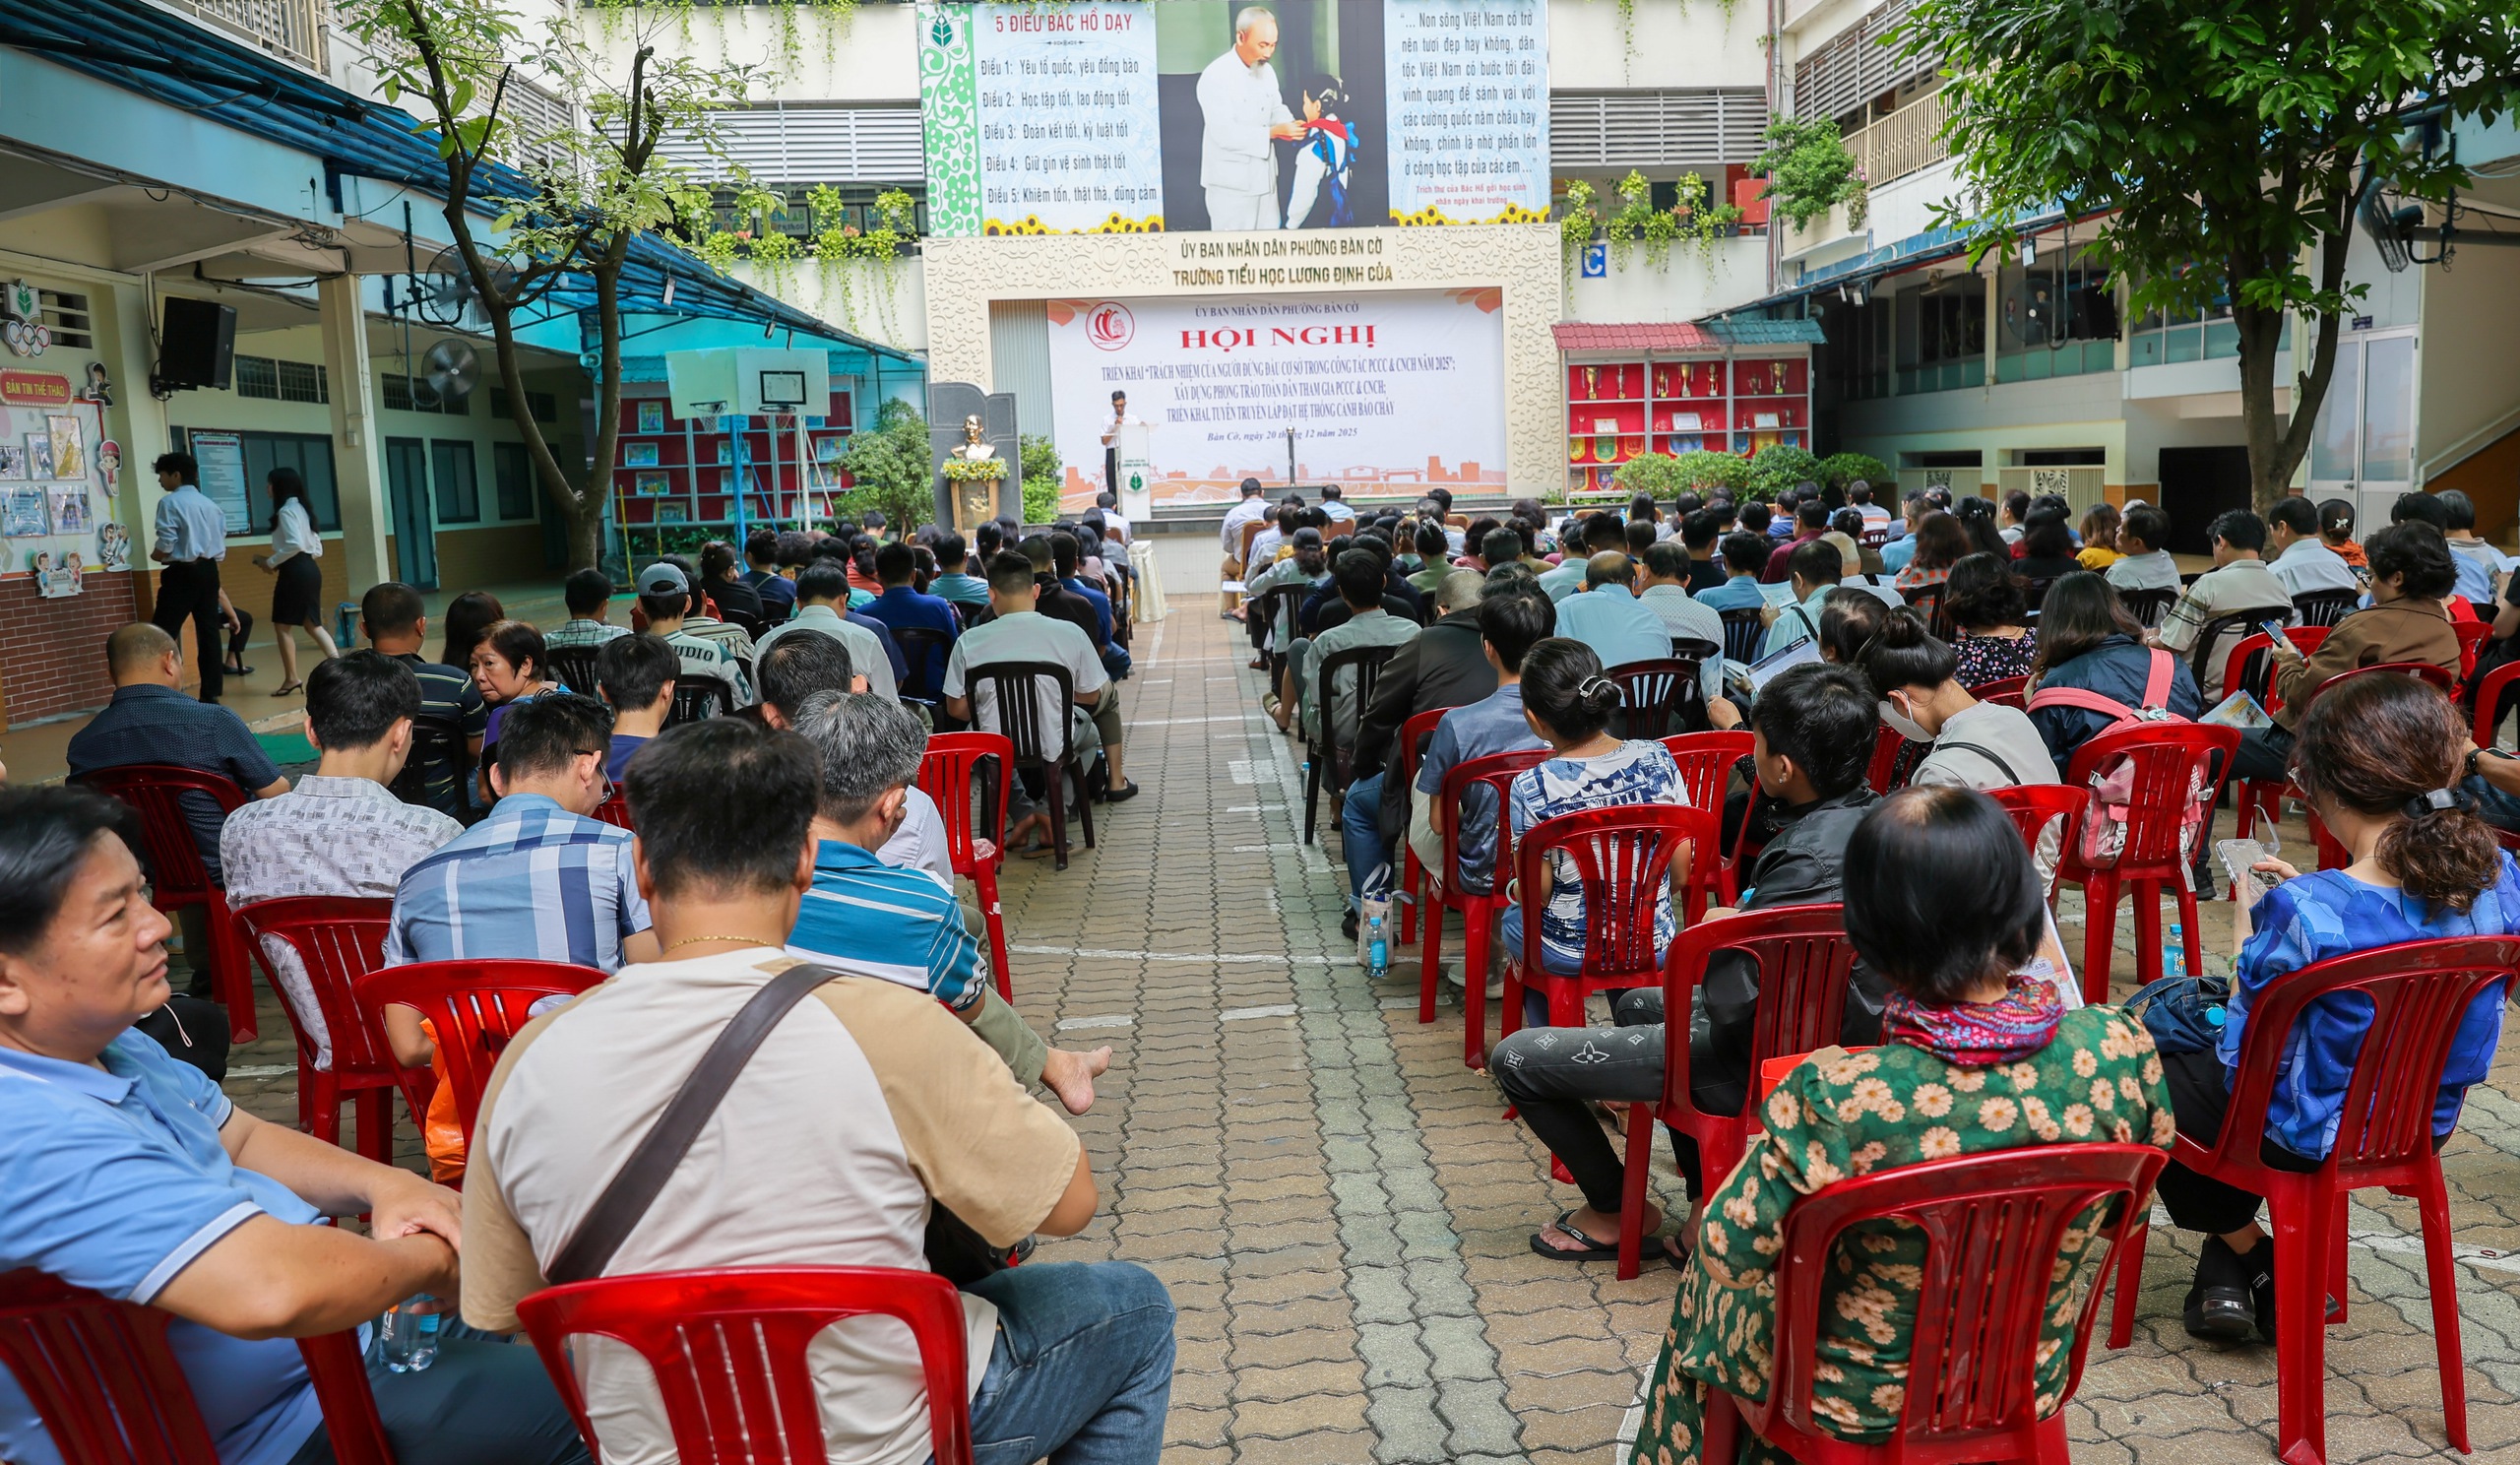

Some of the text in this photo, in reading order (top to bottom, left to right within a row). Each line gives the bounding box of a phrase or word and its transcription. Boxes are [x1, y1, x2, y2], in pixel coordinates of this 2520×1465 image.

[996, 7, 1132, 33] 5 ĐIỀU BÁC HỒ DẠY
[1419, 13, 1435, 28] Non
[1439, 13, 1460, 30] sông
[1464, 12, 1480, 30] Việt
[1484, 12, 1503, 27] Nam
[1507, 11, 1516, 26] có
[1402, 35, 1534, 55] nên tươi đẹp hay không, dân
[981, 55, 1139, 78] Điều 1: Yêu tổ quốc, yêu đồng bào
[1403, 59, 1535, 80] tộc Việt Nam có bước tới đài
[982, 88, 1130, 110] Điều 2: Học tập tốt, lao động tốt
[1403, 83, 1535, 104] vinh quang để sánh vai với
[1404, 108, 1536, 129] các cường quốc năm châu hay
[984, 119, 1128, 141] Điều 3: Đoàn kết tốt, kỷ luật tốt
[1404, 132, 1537, 154] không, chính là nhờ phần lớn
[986, 151, 1126, 173] Điều 4: Giữ gìn vệ sinh thật tốt
[1414, 159, 1433, 177] công
[1437, 160, 1452, 176] học
[1455, 159, 1468, 178] tập
[1472, 157, 1486, 173] của
[1489, 158, 1504, 173] các
[1506, 160, 1519, 173] em
[988, 182, 1157, 205] Điều 5: Khiêm tốn, thật thà, dũng cảm
[1181, 236, 1383, 258] ỦY BAN NHÂN DÂN PHƯỜNG BÀN CỜ
[1584, 248, 1603, 275] C
[1173, 262, 1392, 287] TRƯỜNG TIỂU HỌC LƯƠNG ĐỊNH CỦA
[1195, 305, 1209, 317] ỦY
[1212, 307, 1229, 316] BAN
[1231, 303, 1258, 316] NHÂN
[1261, 303, 1280, 315] DÂN
[1325, 302, 1343, 313] BÀN
[1179, 325, 1377, 352] HỘI NGHỊ
[1389, 358, 1395, 372] &
[6, 379, 65, 397] BẢN TIN THỂ THAO
[1356, 381, 1361, 394] &
[674, 645, 714, 662] UDIO
